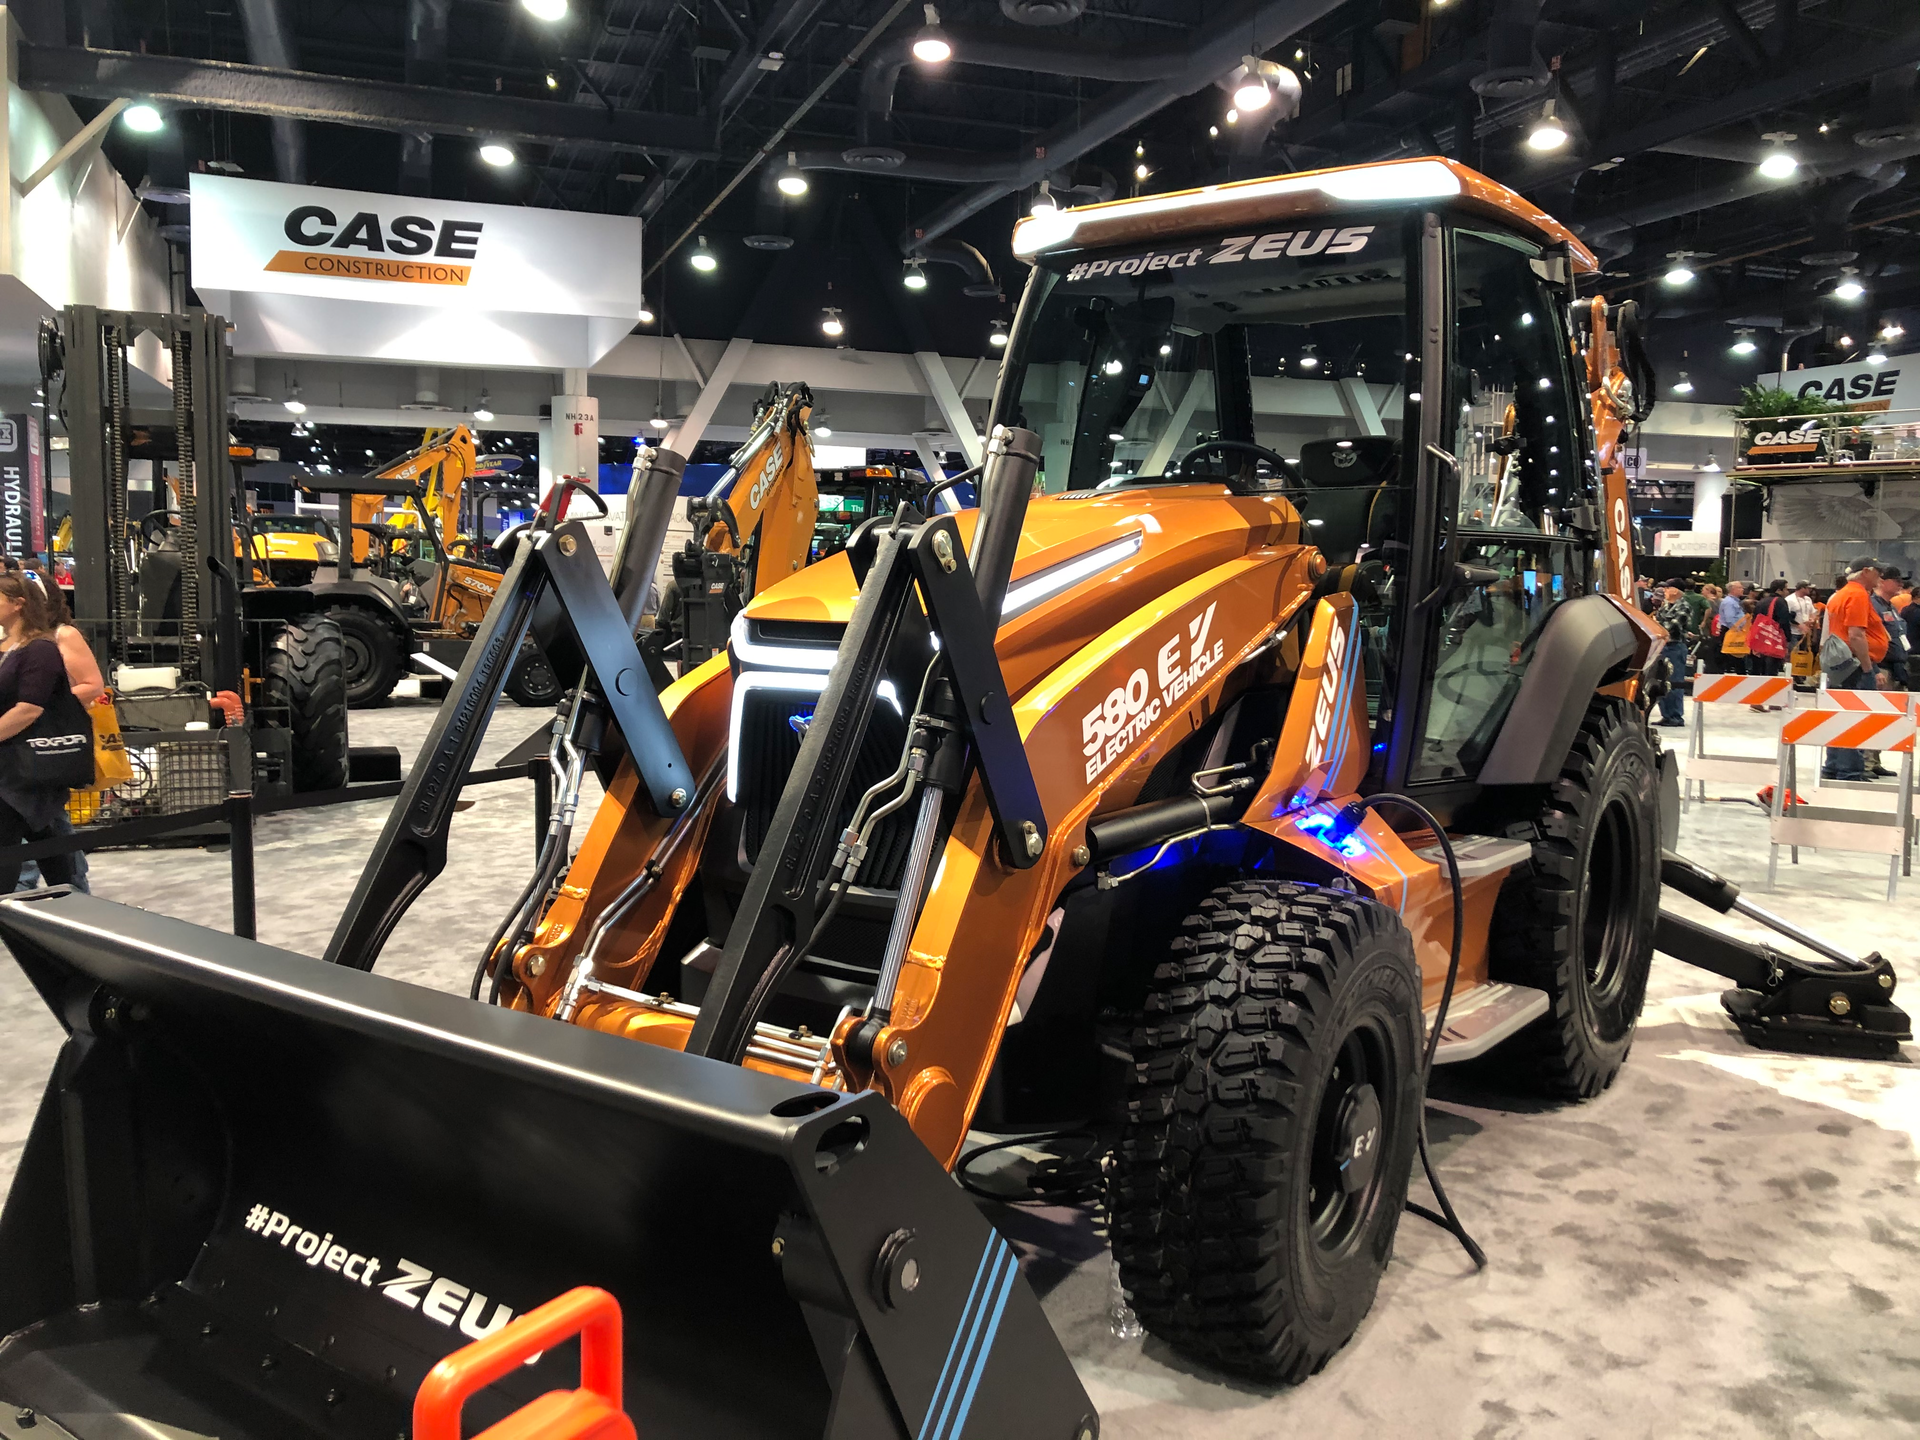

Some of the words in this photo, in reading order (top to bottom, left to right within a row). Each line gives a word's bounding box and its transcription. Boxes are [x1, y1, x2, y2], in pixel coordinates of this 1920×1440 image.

[284, 205, 484, 260] CASE
[1066, 247, 1203, 282] #Project
[1205, 225, 1376, 265] ZEUS
[304, 256, 464, 283] CONSTRUCTION
[1798, 369, 1901, 401] CASE
[1754, 430, 1822, 446] CASE
[395, 464, 418, 480] ASE
[750, 440, 784, 511] CASE
[3, 466, 22, 560] HYDRAULI
[1082, 668, 1149, 757] 580
[1086, 697, 1162, 785] ELECTRIC
[1161, 638, 1225, 708] VEHICLE
[1305, 614, 1346, 773] ZEUS
[244, 1203, 381, 1288] #Project
[377, 1257, 544, 1365] ZEU
